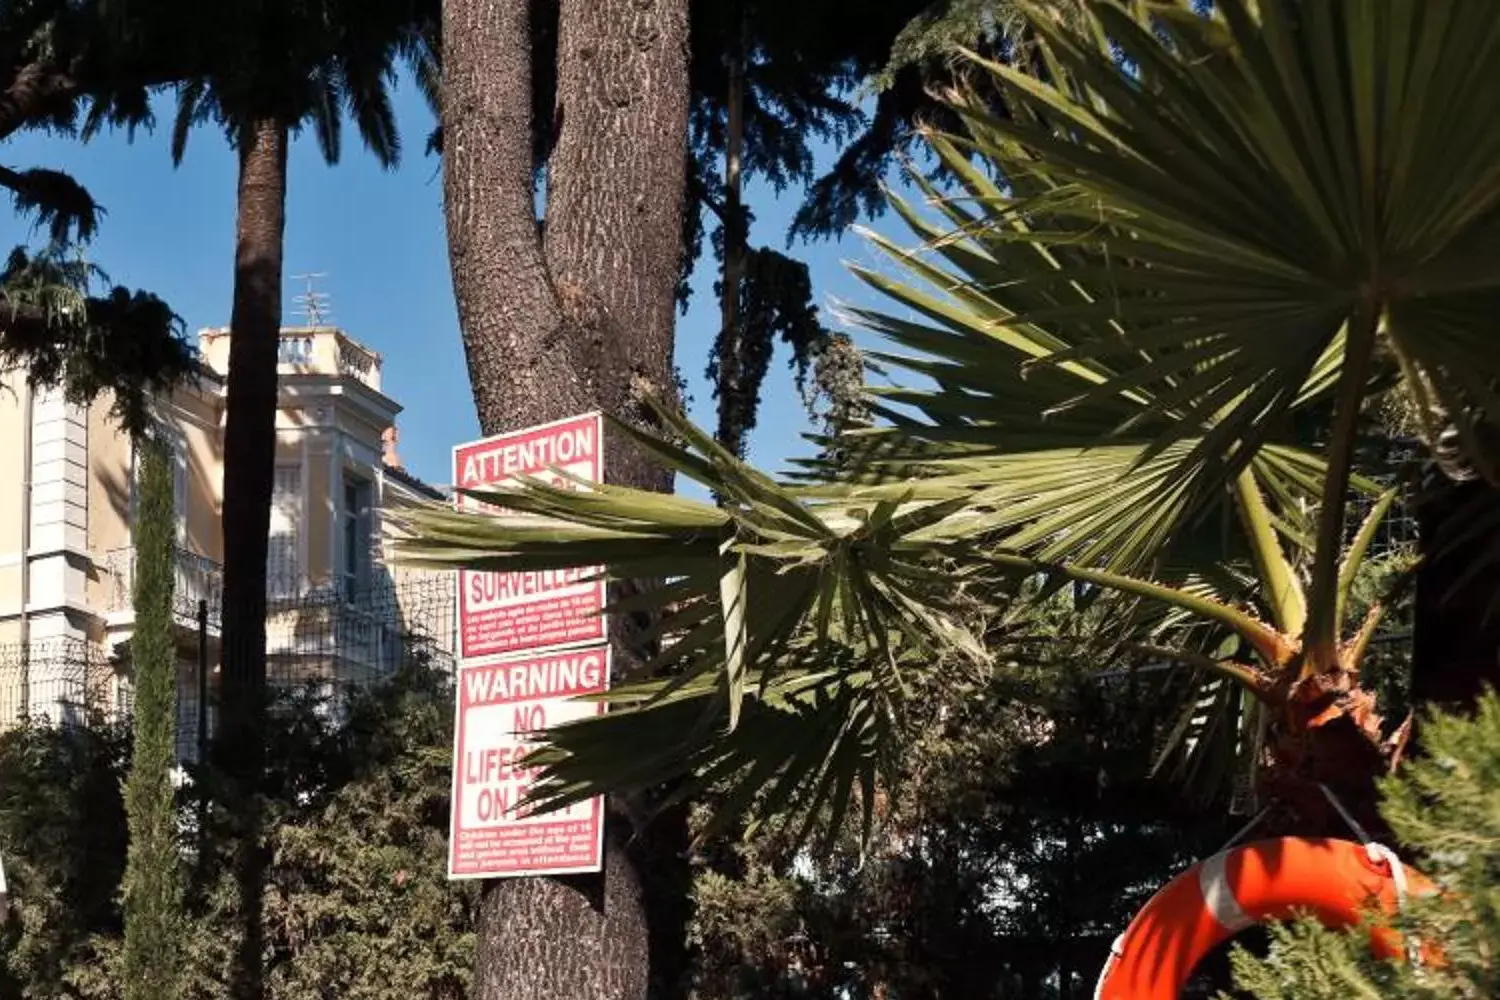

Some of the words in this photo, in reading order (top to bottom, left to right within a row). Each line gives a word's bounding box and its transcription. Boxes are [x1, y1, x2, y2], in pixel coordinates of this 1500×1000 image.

[463, 427, 592, 485] ATTENTION
[466, 655, 599, 704] WARNING
[514, 704, 546, 740] NO
[477, 786, 509, 820] ON
